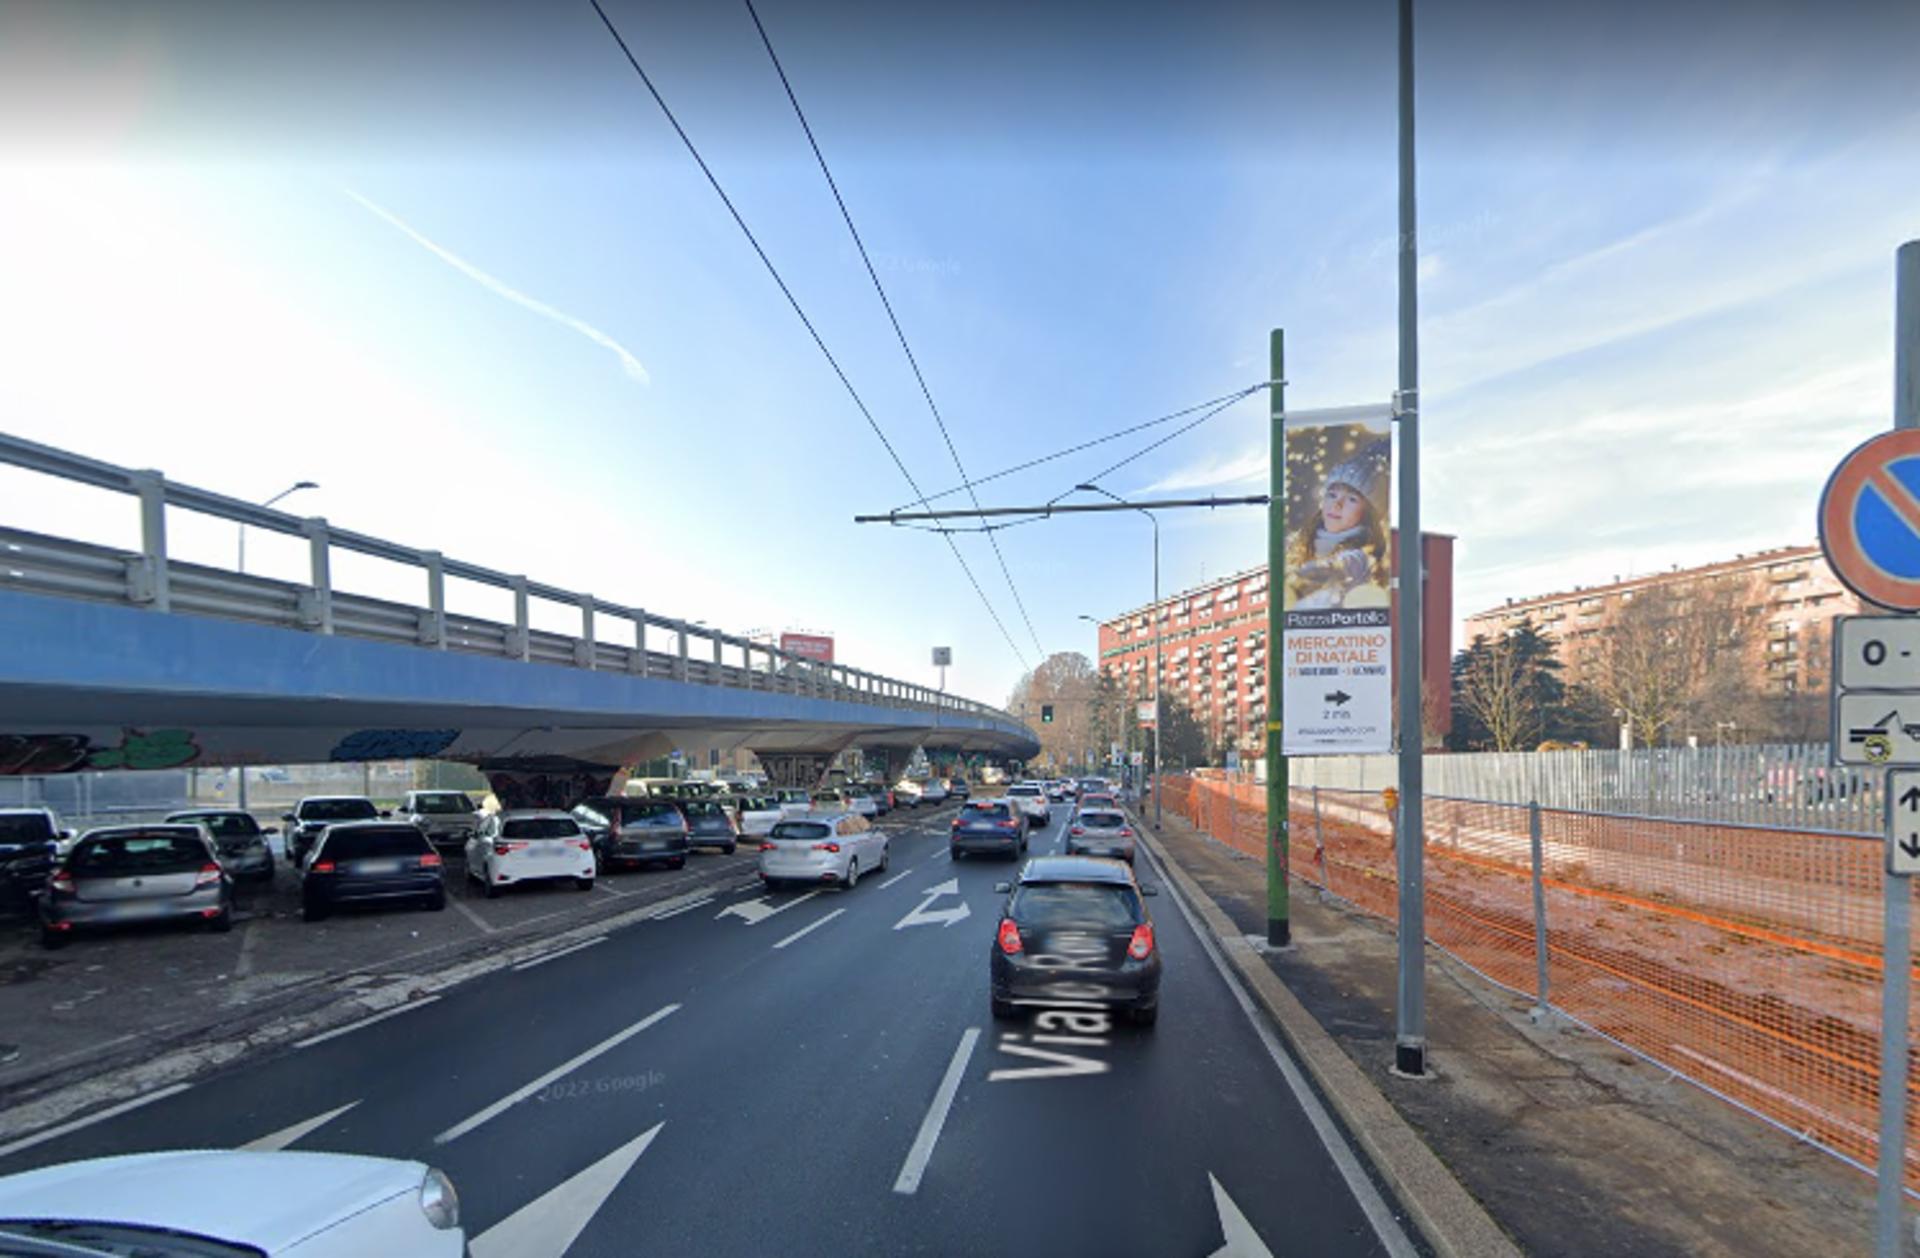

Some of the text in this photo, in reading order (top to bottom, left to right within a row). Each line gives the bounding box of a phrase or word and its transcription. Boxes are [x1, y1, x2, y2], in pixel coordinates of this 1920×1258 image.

[1287, 634, 1386, 651] MERCATINO
[1295, 649, 1379, 664] DI NATALE
